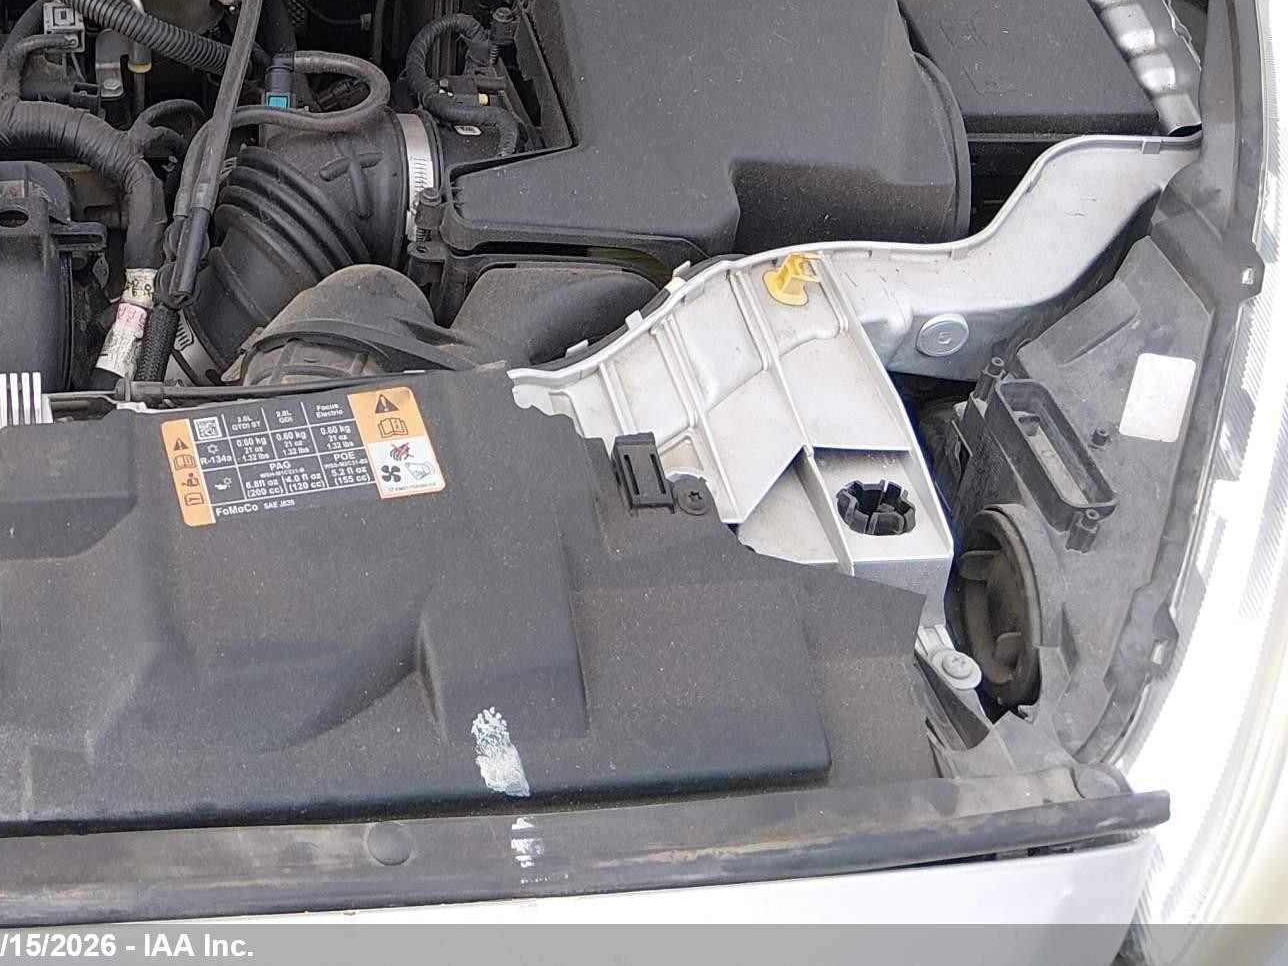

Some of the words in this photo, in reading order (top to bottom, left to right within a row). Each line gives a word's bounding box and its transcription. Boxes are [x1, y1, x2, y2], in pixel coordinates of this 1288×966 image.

[316, 403, 340, 411] Focus
[315, 410, 344, 418] Electric
[319, 426, 338, 435] 0.60
[339, 425, 351, 434] kg
[275, 432, 294, 441] 0.60
[295, 430, 307, 439] kg
[236, 438, 254, 447] 0.60
[255, 437, 267, 445] kg
[326, 442, 342, 450] 1.32
[282, 448, 297, 456] 1.32
[298, 446, 310, 454] lbs
[333, 451, 356, 461] POE
[200, 455, 232, 465] R-134a
[242, 454, 257, 462] 1.32
[269, 461, 292, 471] PAG
[331, 467, 345, 477] 5.2
[346, 466, 353, 474] fl
[285, 474, 300, 483] 4.0
[302, 473, 309, 481] fl
[310, 472, 322, 480] oz
[334, 475, 355, 485] (155
[356, 473, 371, 482] cc)
[289, 482, 309, 492] (120
[310, 480, 325, 489] cc)
[246, 487, 267, 498] (200
[268, 486, 283, 495] cc)
[215, 503, 259, 516] FoMoCo
[263, 501, 278, 509] SAE
